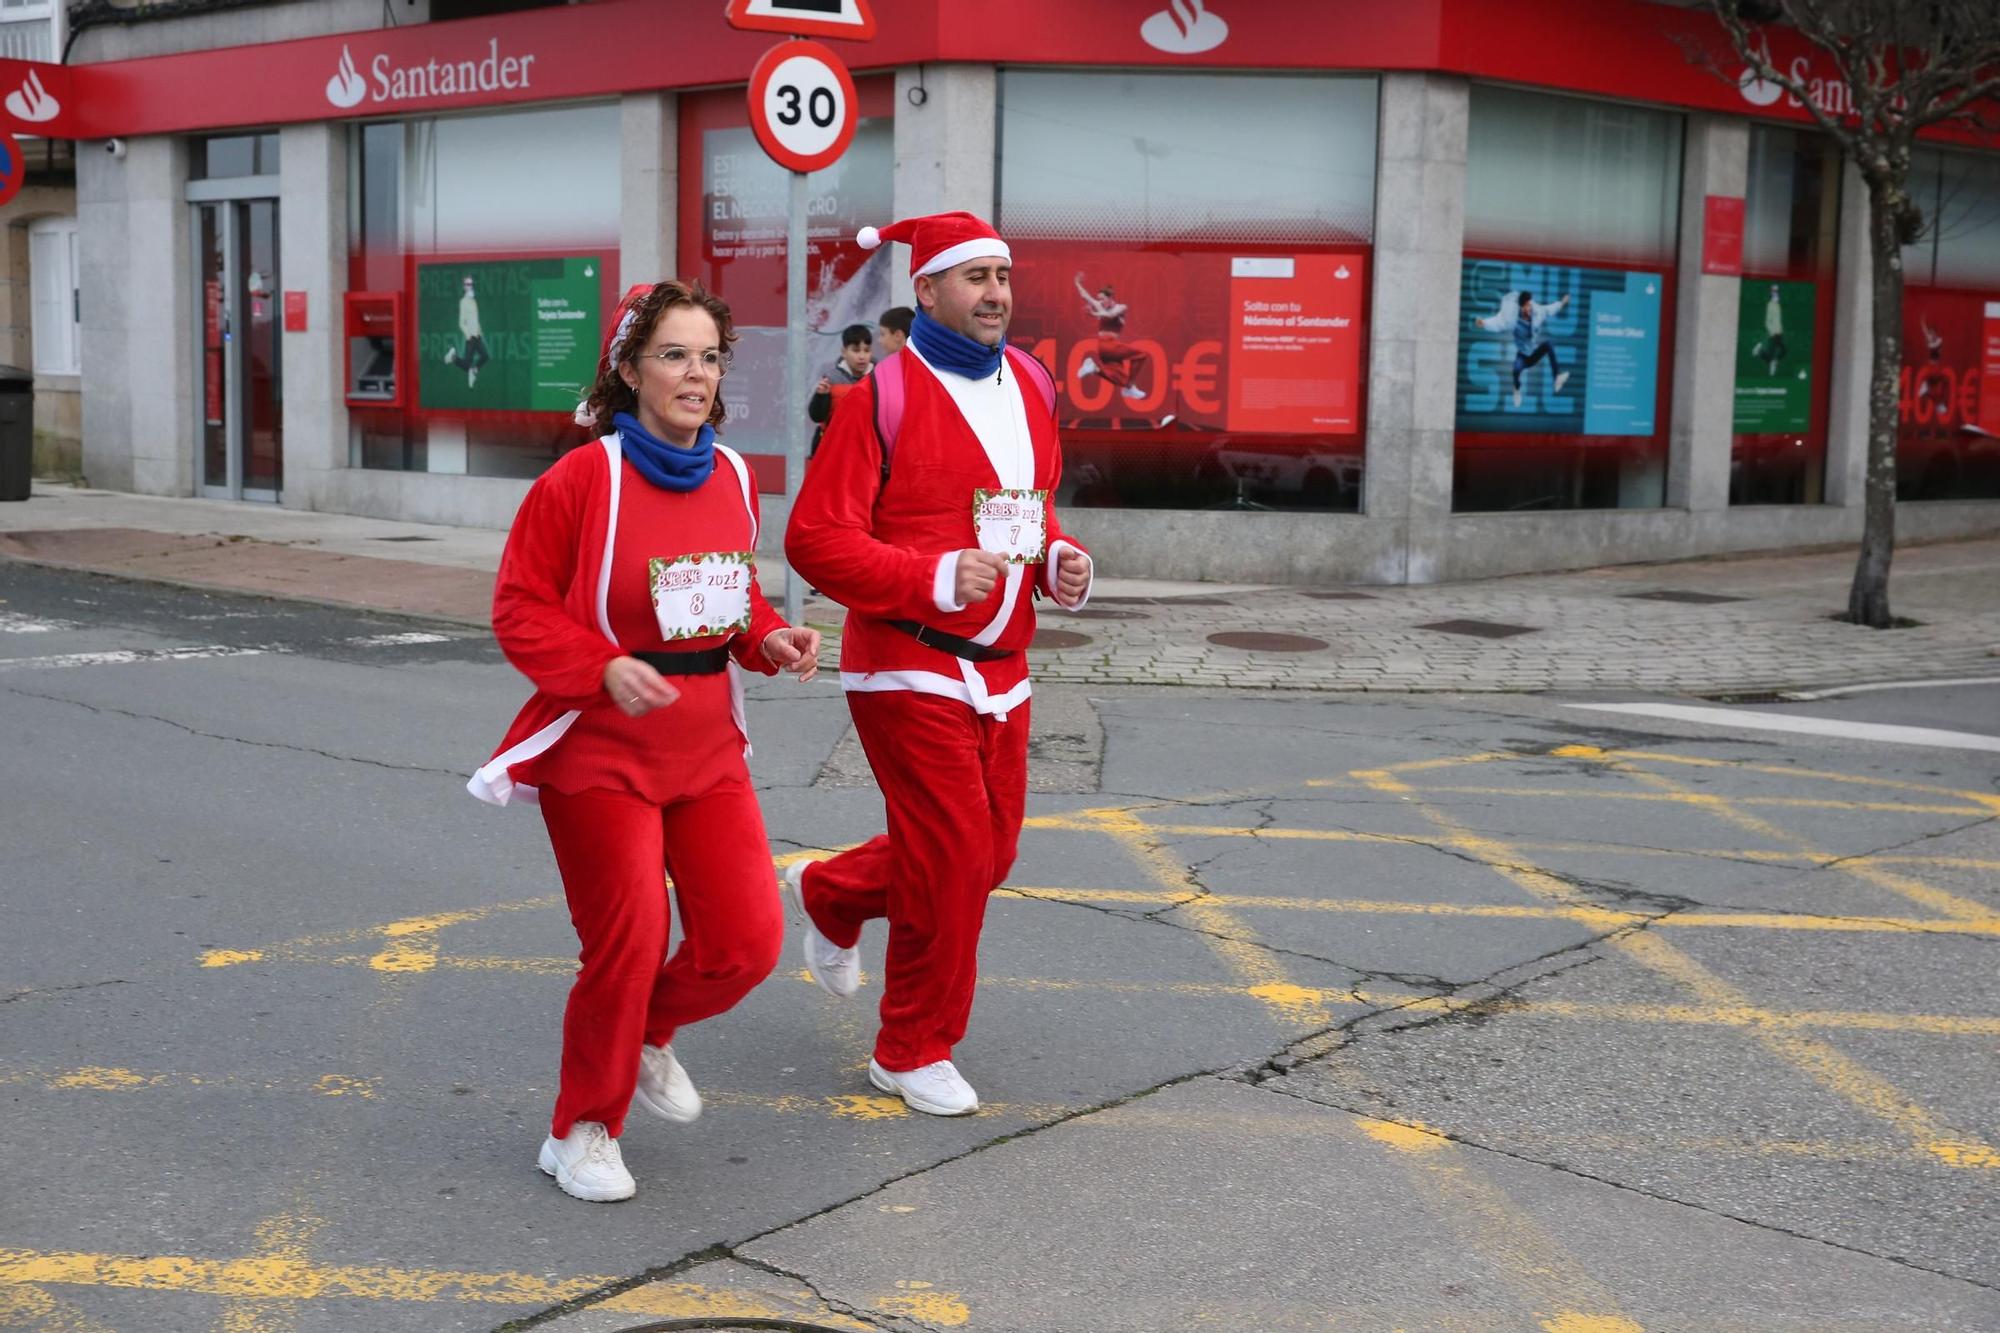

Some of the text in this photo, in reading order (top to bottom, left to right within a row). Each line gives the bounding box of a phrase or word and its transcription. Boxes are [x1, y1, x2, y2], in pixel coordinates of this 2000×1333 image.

[372, 36, 535, 103] Santander
[776, 85, 836, 128] 30
[713, 201, 729, 220] EL
[807, 195, 837, 216] GRO
[1271, 303, 1288, 312] con
[1296, 316, 1350, 328] Santander
[1010, 525, 1021, 546] 7
[690, 593, 705, 615] 8
